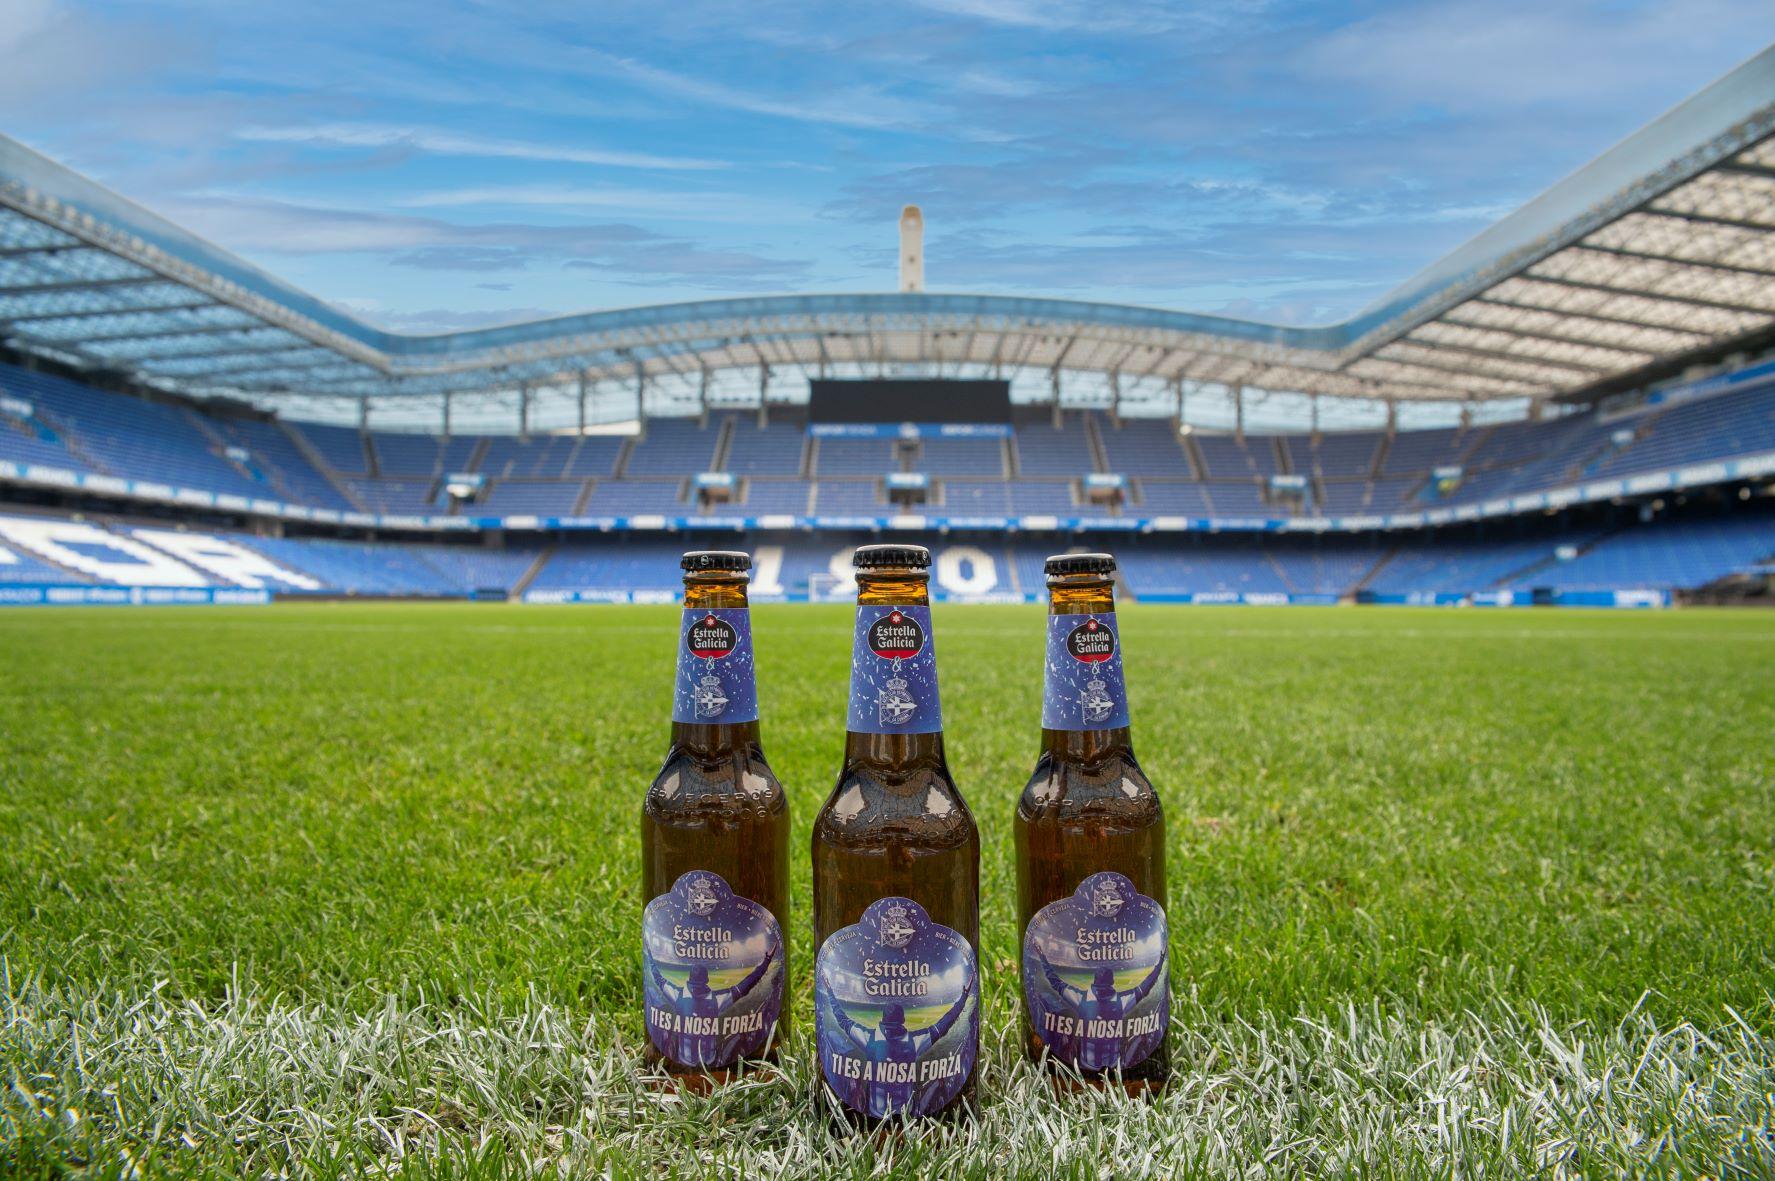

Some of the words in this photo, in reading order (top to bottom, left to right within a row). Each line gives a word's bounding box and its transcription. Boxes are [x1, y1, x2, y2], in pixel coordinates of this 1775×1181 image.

[693, 628, 729, 639] Estrella
[876, 625, 916, 637] Estrella
[1075, 632, 1110, 643] Estrella
[694, 638, 728, 649] Galicia
[877, 636, 915, 648] Galicia
[1076, 642, 1109, 654] Galicia
[672, 924, 732, 942] Estrella
[1076, 927, 1136, 944] Estrella
[676, 942, 730, 960] Galicia
[1078, 943, 1135, 961] Galicia
[862, 959, 930, 977] Estrella
[864, 976, 928, 996] Galicia
[650, 1006, 658, 1027] TI
[659, 1011, 672, 1030] ES
[674, 1015, 682, 1033] A
[1044, 1012, 1054, 1032] TI
[1057, 1016, 1072, 1034] ES
[1075, 1018, 1084, 1037] A
[832, 1053, 842, 1075] TI
[844, 1057, 860, 1080] ES
[863, 1061, 872, 1081] A
